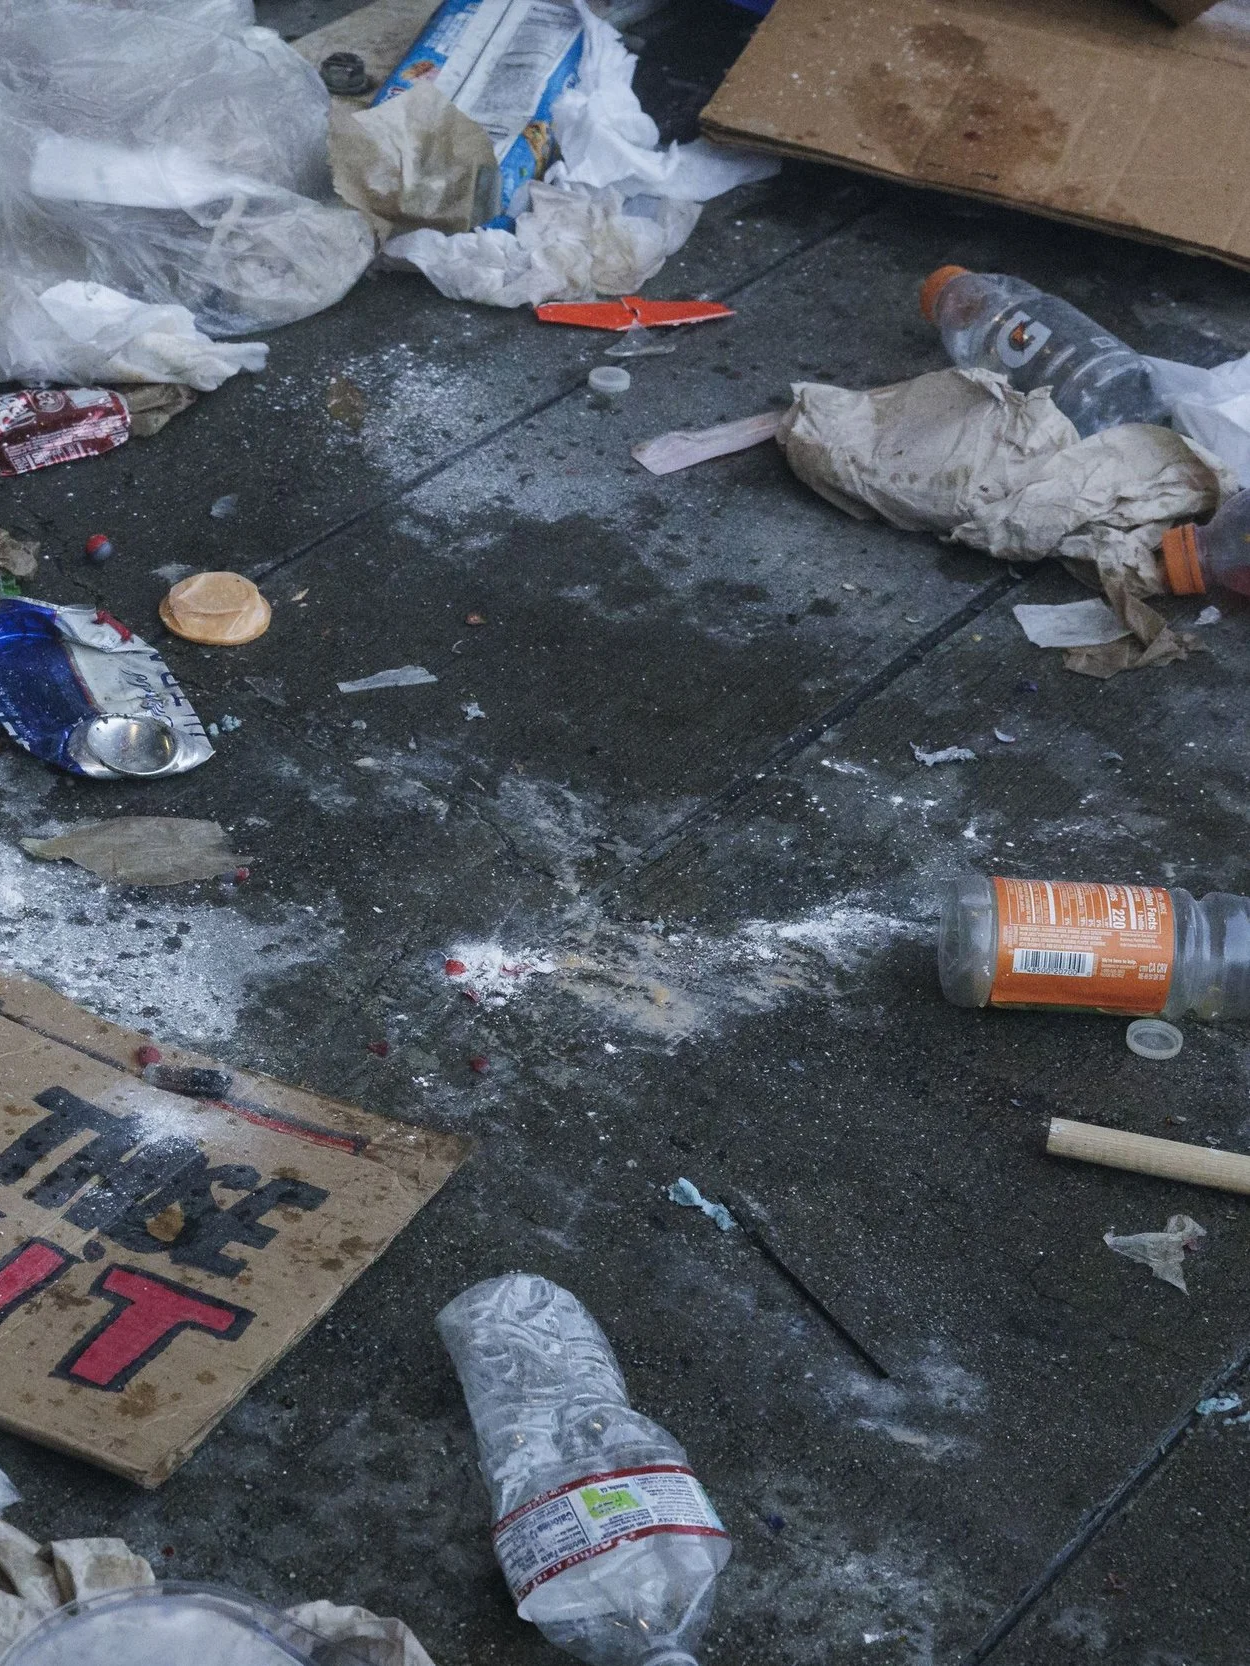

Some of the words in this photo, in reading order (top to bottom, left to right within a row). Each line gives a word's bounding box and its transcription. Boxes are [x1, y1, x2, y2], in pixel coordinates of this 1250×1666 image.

[1111, 907, 1126, 930] 220
[1147, 907, 1158, 930] Facts
[1054, 968, 1078, 976] 20700
